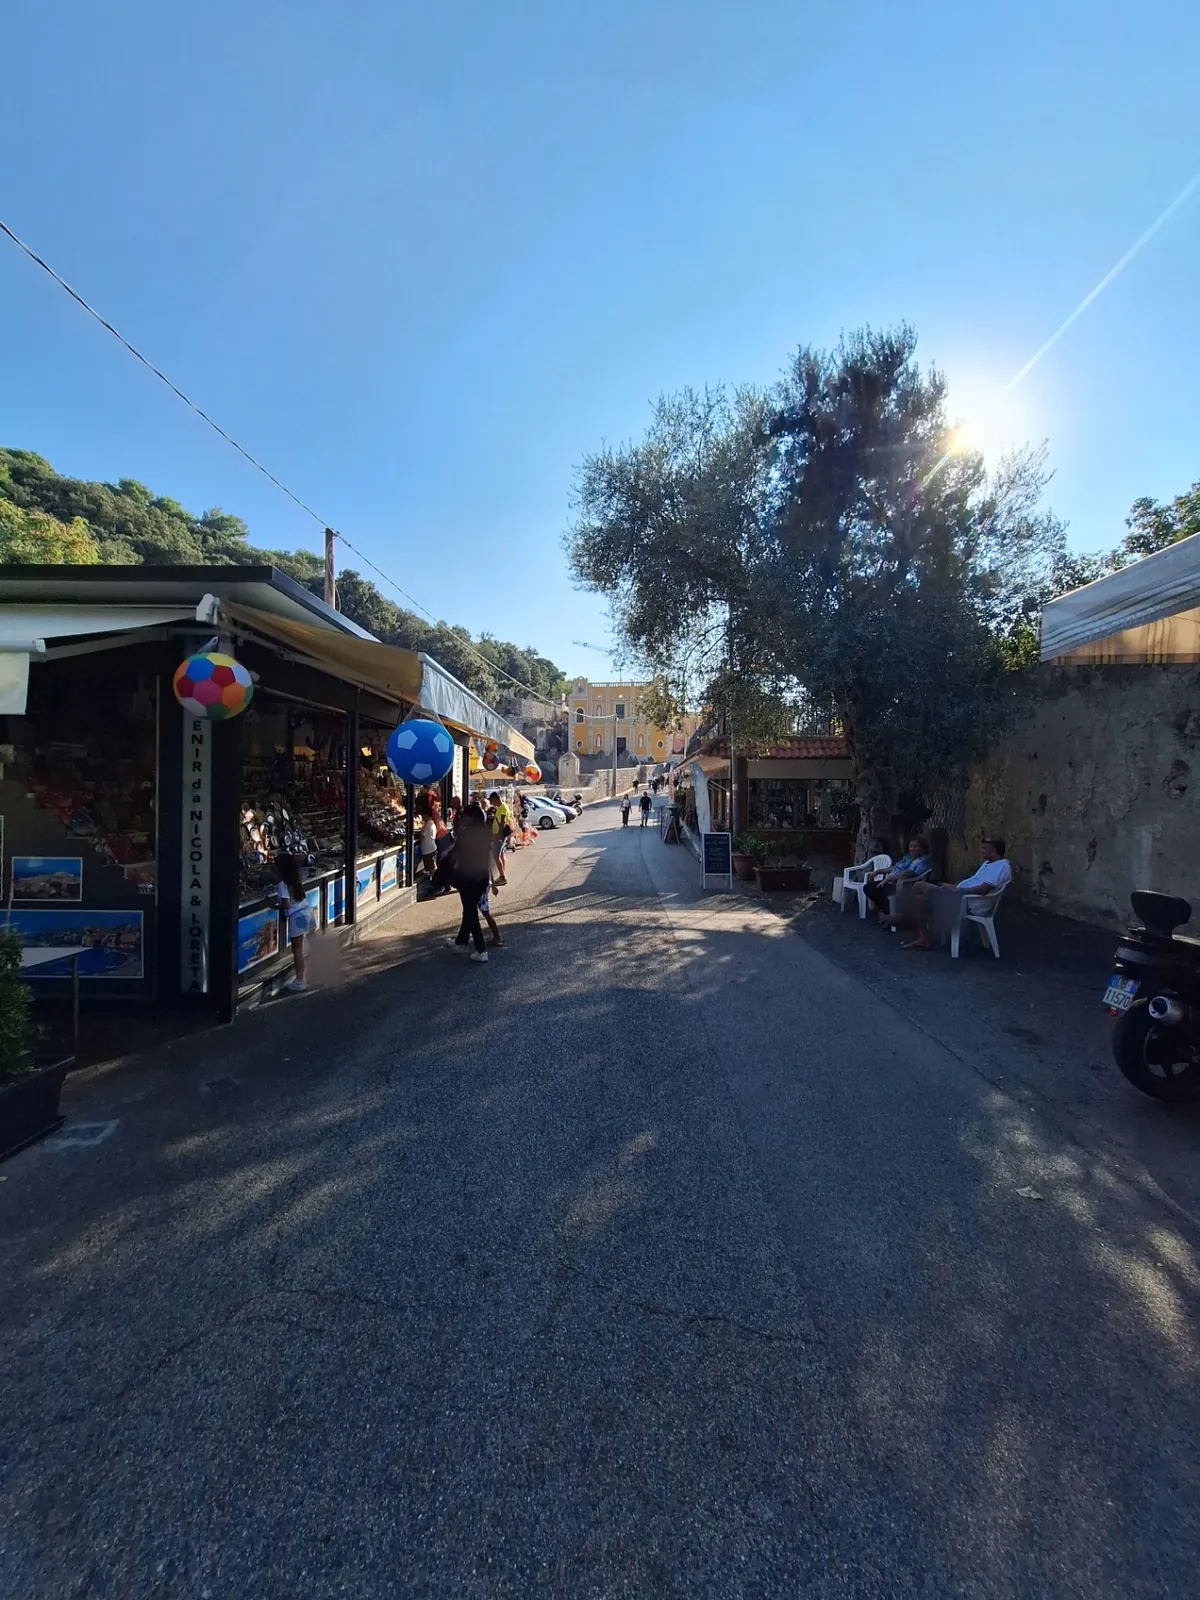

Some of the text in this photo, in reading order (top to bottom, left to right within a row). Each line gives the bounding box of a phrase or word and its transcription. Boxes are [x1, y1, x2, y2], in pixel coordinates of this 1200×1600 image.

[189, 720, 203, 990] ENIR da NICOLA & LORETA
[1106, 989, 1131, 1007] 11570
